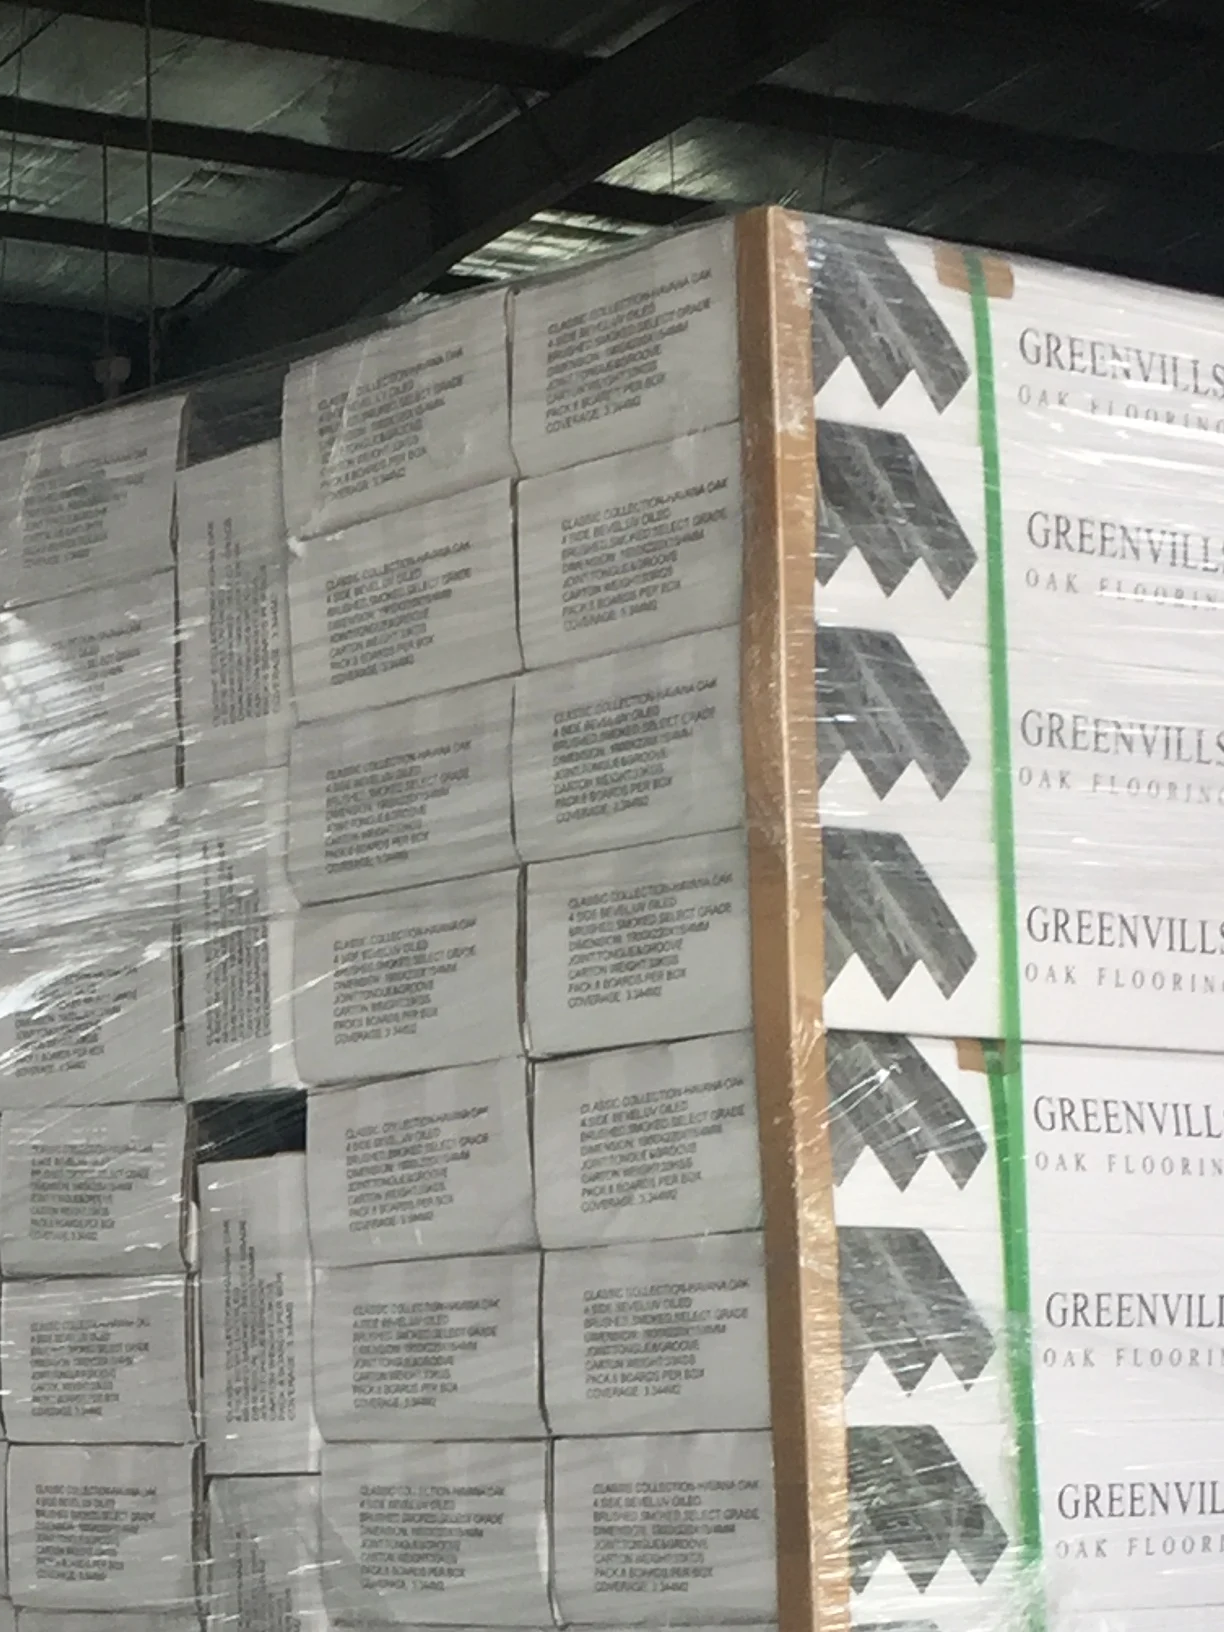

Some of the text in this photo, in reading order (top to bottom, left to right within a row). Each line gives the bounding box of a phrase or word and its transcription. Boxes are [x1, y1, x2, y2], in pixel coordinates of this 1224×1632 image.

[1018, 384, 1068, 407] OAK
[1028, 511, 1224, 572] GREENVILL
[1026, 569, 1218, 610] OAK FLOORIN
[1019, 766, 1071, 789] OAK
[1026, 963, 1224, 993] OAK FLOORIN
[1034, 1096, 1224, 1139] GREENVILL
[1036, 1152, 1224, 1176] OAK FLOORIN
[1046, 1292, 1224, 1328] GREENVIL
[1044, 1347, 1224, 1368] OAK FLOORI
[1058, 1481, 1224, 1520] GREENVIL
[1056, 1538, 1108, 1559] OAK
